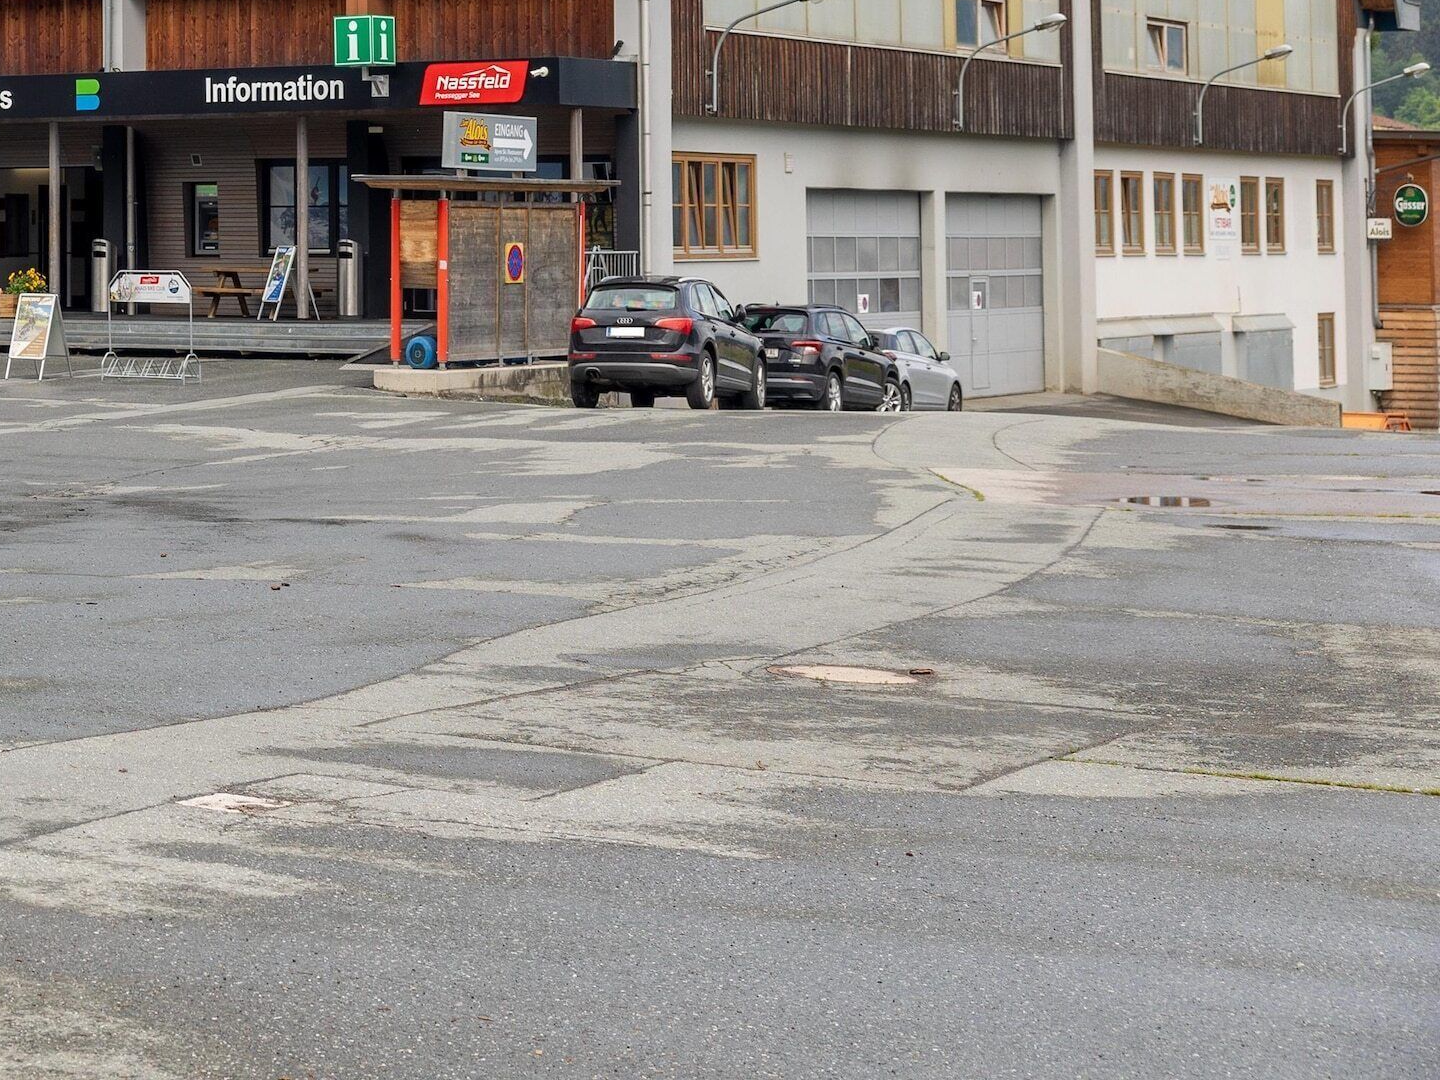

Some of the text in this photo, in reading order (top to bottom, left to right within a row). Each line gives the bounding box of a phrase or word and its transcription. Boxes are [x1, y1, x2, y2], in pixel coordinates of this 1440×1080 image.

[205, 74, 345, 103] Information
[436, 73, 511, 91] Nassfeld
[469, 91, 480, 99] See
[464, 119, 489, 140] Alois
[494, 123, 524, 137] EINGANG
[1395, 197, 1426, 213] Gösser
[1370, 228, 1390, 236] Alois
